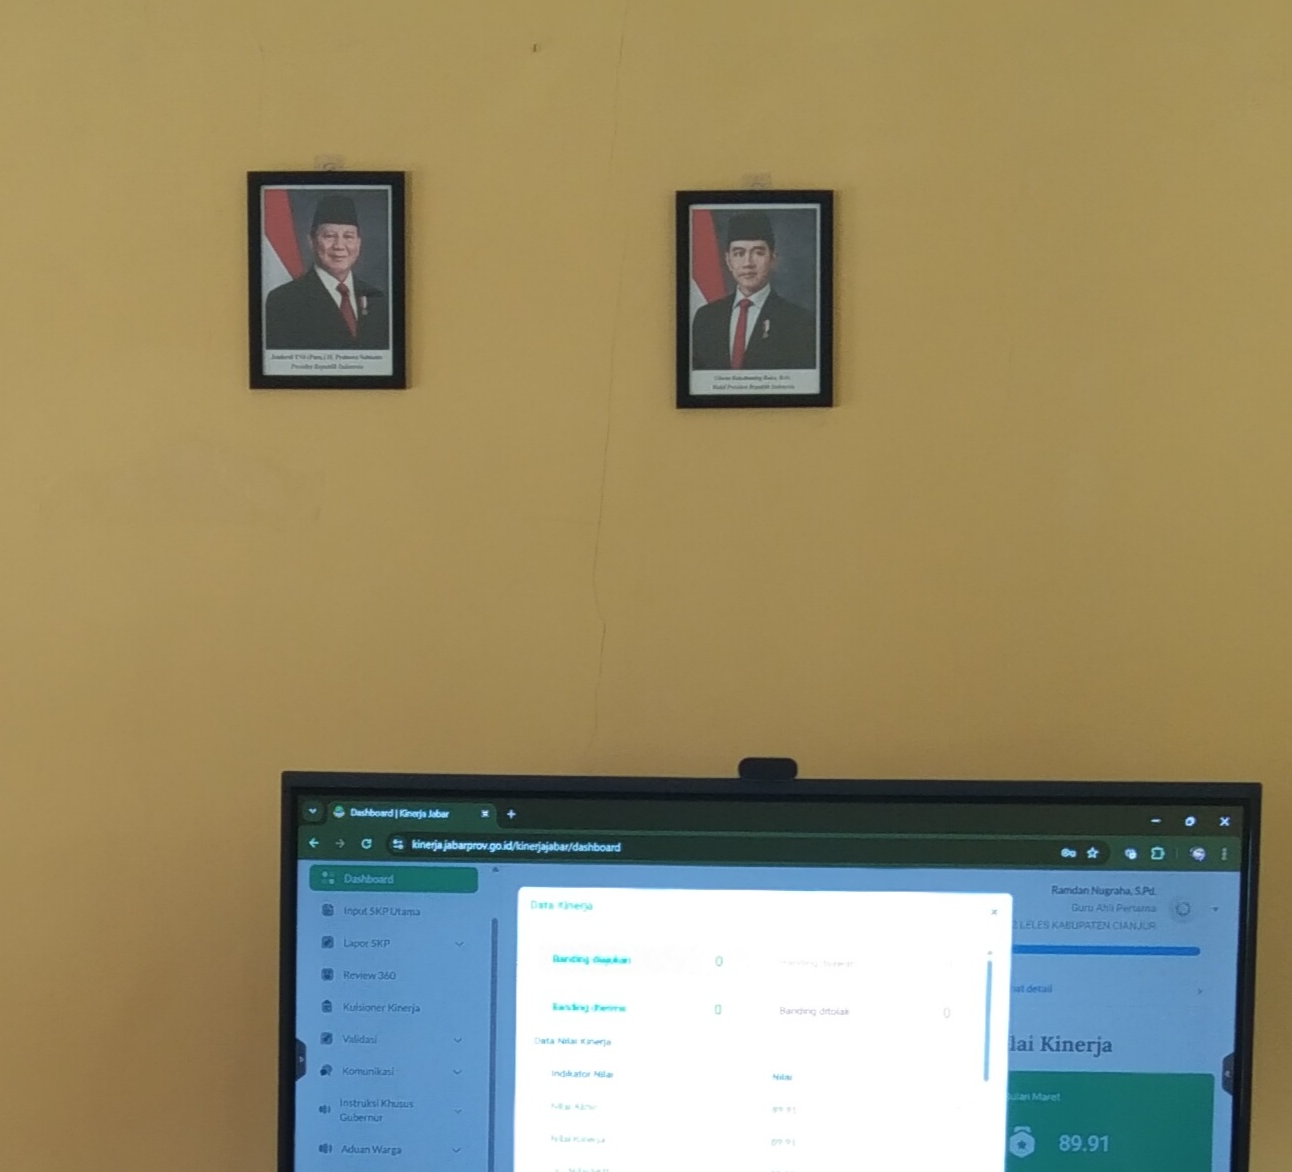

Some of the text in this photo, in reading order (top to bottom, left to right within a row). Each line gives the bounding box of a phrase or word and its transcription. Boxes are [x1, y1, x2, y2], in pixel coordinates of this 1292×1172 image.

[350, 808, 394, 819] Dashboard
[399, 809, 426, 820] Kinerja
[428, 809, 449, 819] Jabar
[412, 839, 621, 853] kinerja.jabarprov.go.id/kinerjajabar/dashboard
[343, 873, 394, 885] Dashboard
[1052, 886, 1089, 895] Ramdan
[531, 901, 554, 910] Data
[1072, 904, 1094, 912] Guru
[1117, 904, 1156, 912] Pertama
[344, 906, 420, 918] Input SKP Utama
[1020, 921, 1049, 929] LELES
[1052, 921, 1110, 930] KABUPATEN
[1113, 922, 1156, 930] CIANJUR
[343, 938, 390, 950] Lapor SKP
[343, 971, 396, 980] Review 360
[1027, 984, 1052, 993] detail
[343, 1003, 420, 1014] Kuisioner Kinerja
[780, 1007, 816, 1017] Banding
[342, 1034, 377, 1044] Validasi
[1040, 1036, 1113, 1057] Kinerja
[342, 1066, 394, 1076] Komunikasi
[1032, 1093, 1060, 1101] Maret
[340, 1098, 414, 1108] Instruksi Khusus
[340, 1112, 383, 1122] Gubernur
[1059, 1135, 1108, 1152] 89.91
[341, 1145, 402, 1155] Aduan Warga
